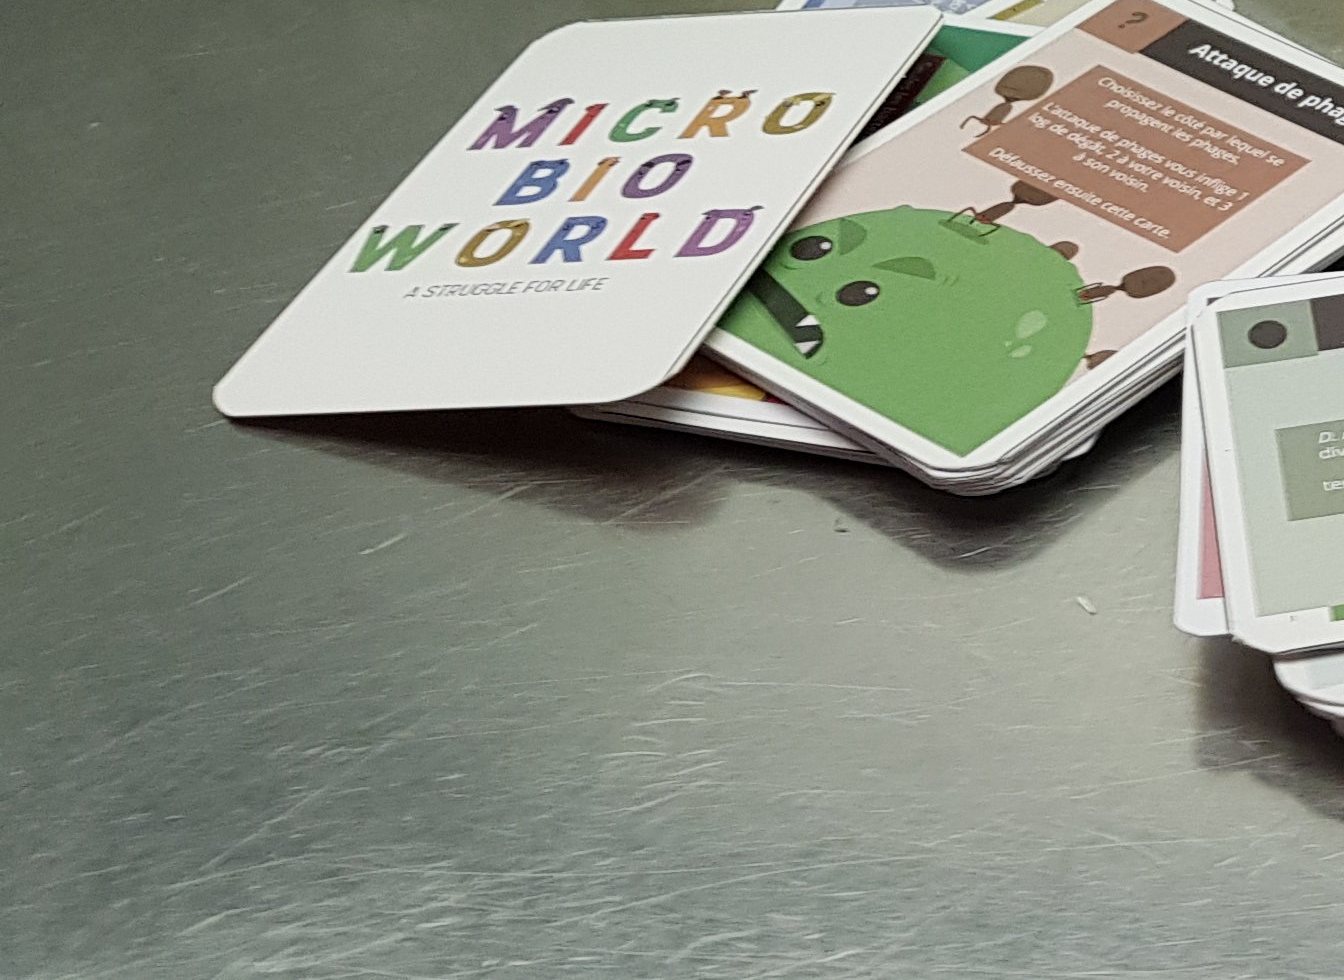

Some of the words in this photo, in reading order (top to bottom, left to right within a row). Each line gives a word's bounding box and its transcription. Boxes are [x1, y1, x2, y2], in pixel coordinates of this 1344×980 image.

[1189, 43, 1274, 87] Attaque
[1273, 77, 1303, 100] de
[466, 89, 835, 151] MICRO
[1098, 77, 1162, 111] Choisissez
[1161, 105, 1176, 117] le
[1173, 112, 1204, 130] côté
[1201, 125, 1229, 140] par
[1227, 135, 1269, 159] lequel
[1266, 154, 1285, 167] se
[1104, 99, 1174, 134] propagent
[1171, 127, 1193, 142] les
[492, 153, 694, 206] BIO
[988, 147, 1056, 183] Défaussez
[1053, 178, 1103, 207] ensuite
[1101, 201, 1136, 221] cette
[1027, 112, 1052, 129] log
[1049, 123, 1069, 137] de
[1105, 149, 1120, 161] 2
[1116, 154, 1130, 166] à
[1128, 160, 1164, 181] votre
[1203, 194, 1221, 207] et
[1217, 201, 1233, 212] 3
[1071, 151, 1084, 162] à
[1082, 157, 1110, 173] son
[1100, 129, 1119, 143] de
[1116, 137, 1166, 164] phages
[1164, 160, 1197, 179] vous
[1195, 173, 1238, 197] inflige
[1237, 192, 1250, 202] 1
[346, 206, 765, 273] WORLD
[403, 286, 420, 298] A
[421, 281, 524, 298] STRUGGLE
[522, 279, 566, 293] FOR
[565, 277, 610, 292] LIFE
